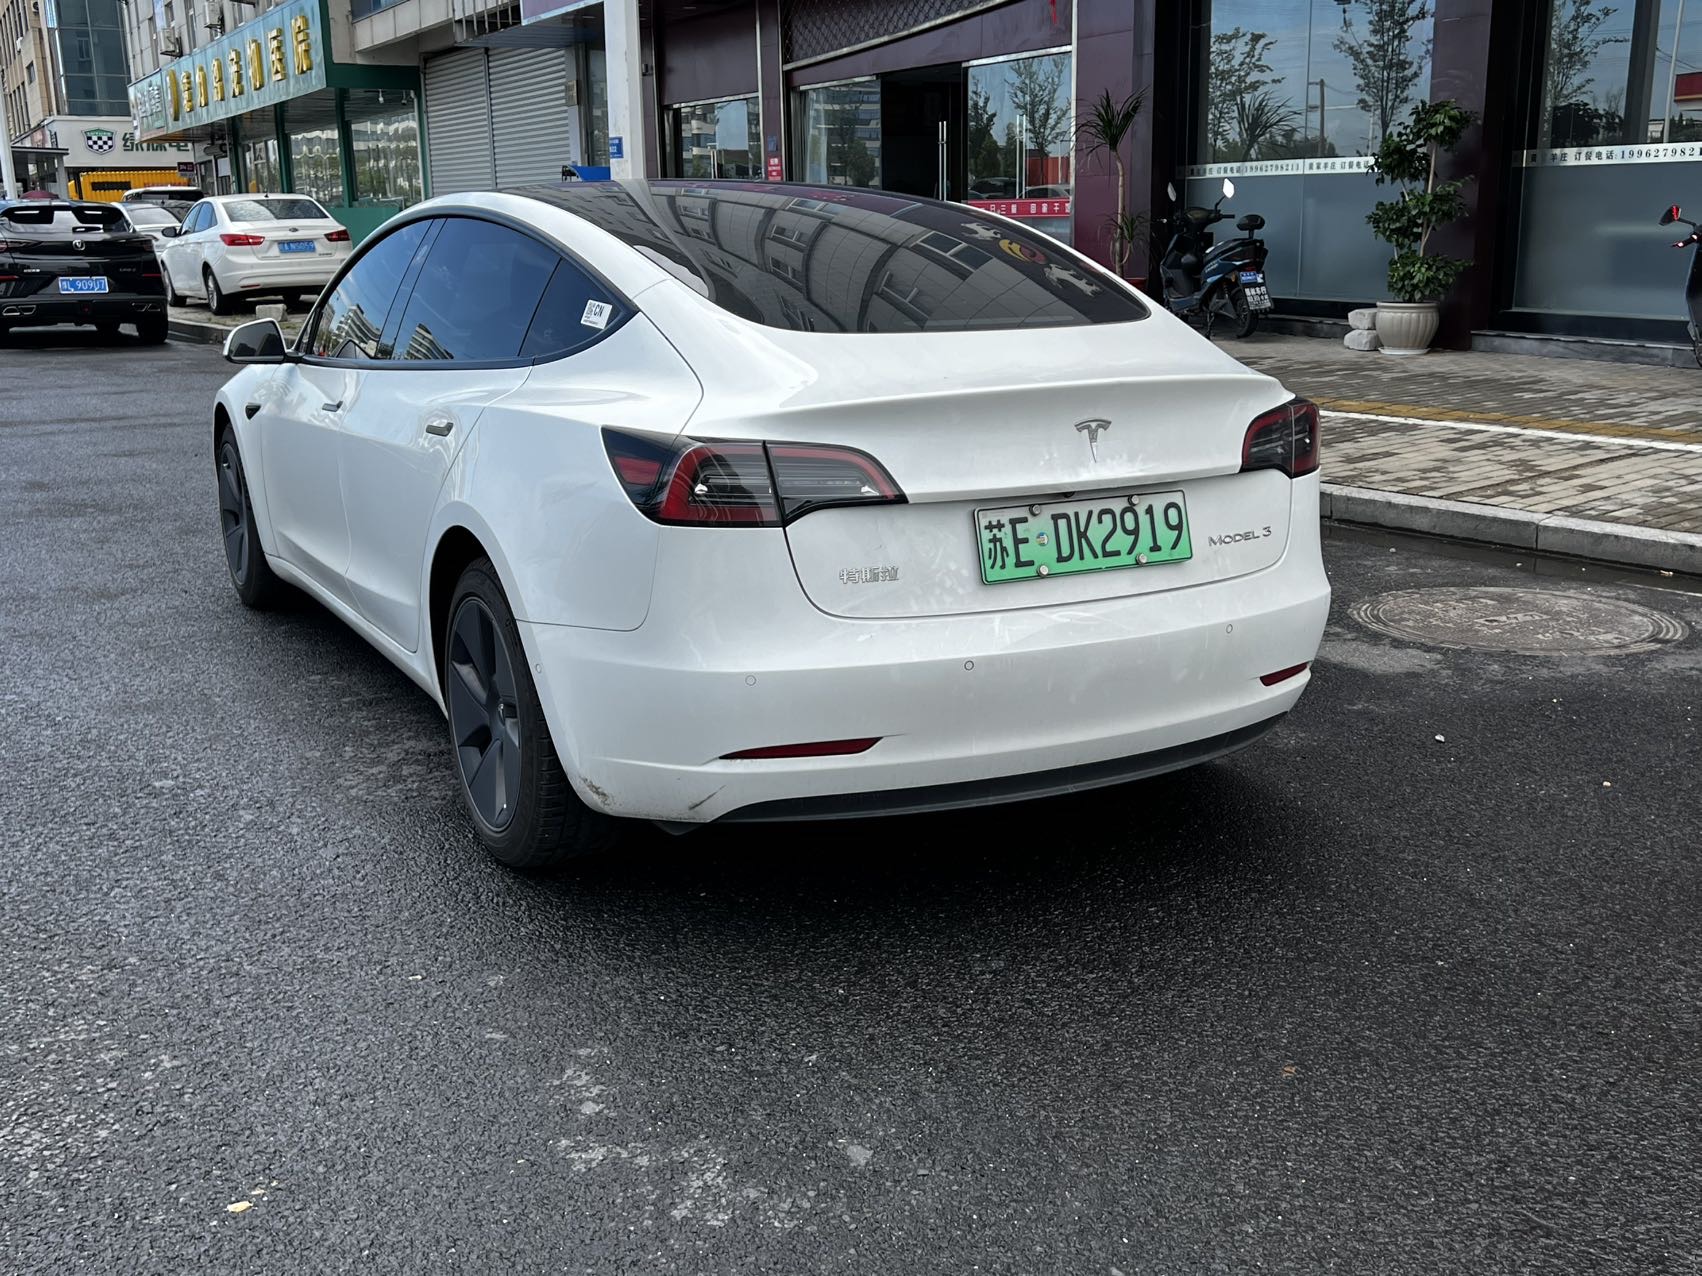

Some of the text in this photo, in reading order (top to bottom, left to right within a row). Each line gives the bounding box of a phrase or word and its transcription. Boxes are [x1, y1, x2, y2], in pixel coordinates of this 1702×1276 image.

[984, 501, 1184, 570] 苏E DK2919
[1208, 525, 1272, 546] MODEL 3
[839, 566, 899, 584] 特斯拉
